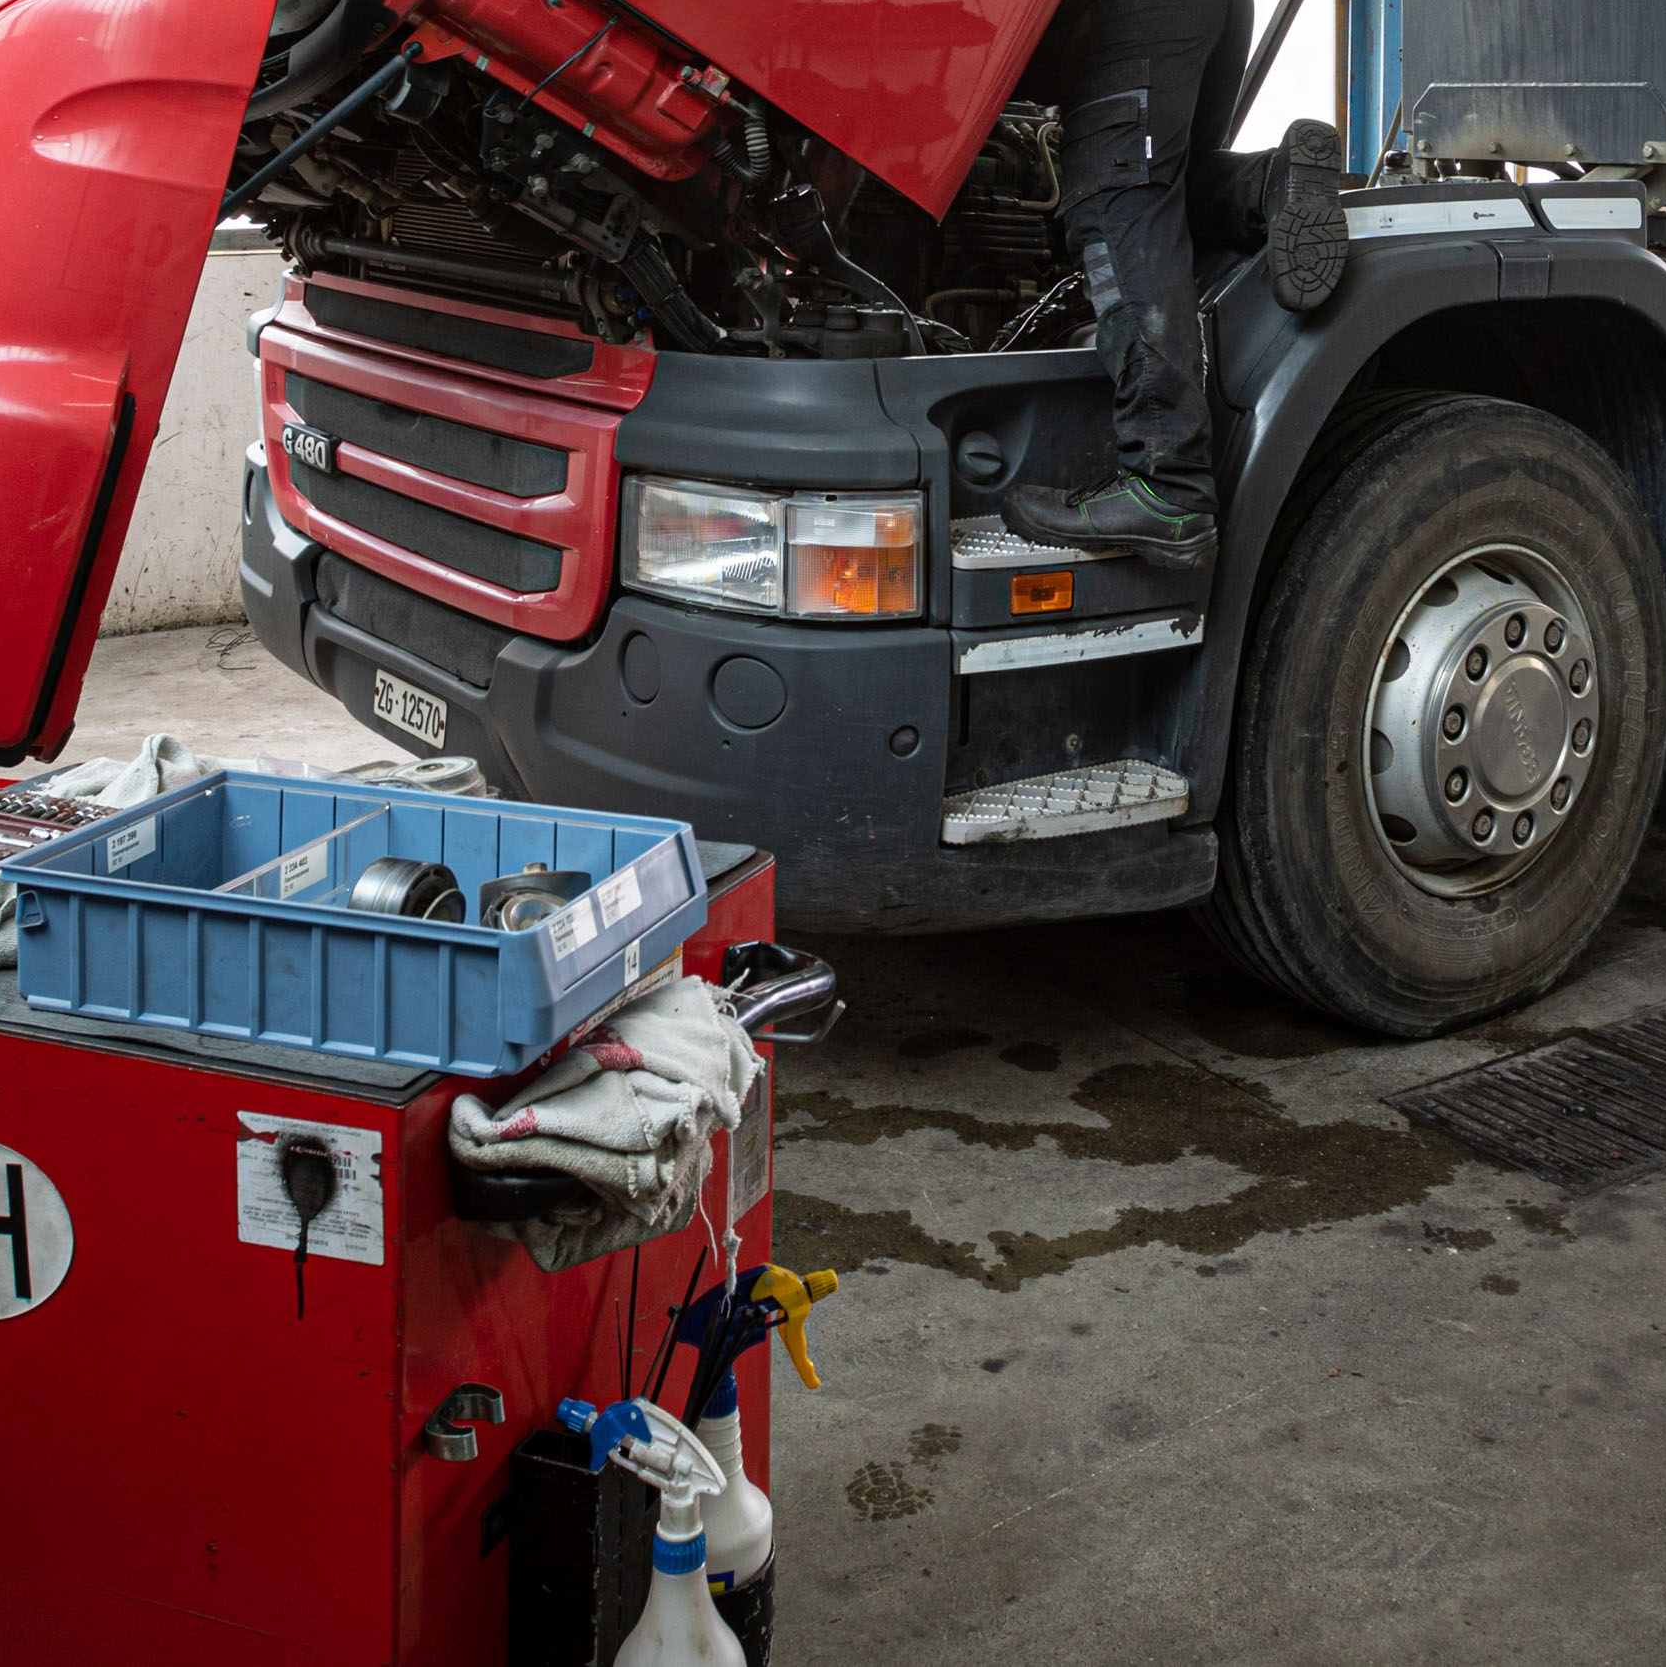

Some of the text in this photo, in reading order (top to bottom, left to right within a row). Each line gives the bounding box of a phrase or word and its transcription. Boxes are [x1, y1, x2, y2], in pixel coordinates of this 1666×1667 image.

[282, 427, 326, 470] G 480
[627, 950, 638, 976] 14
